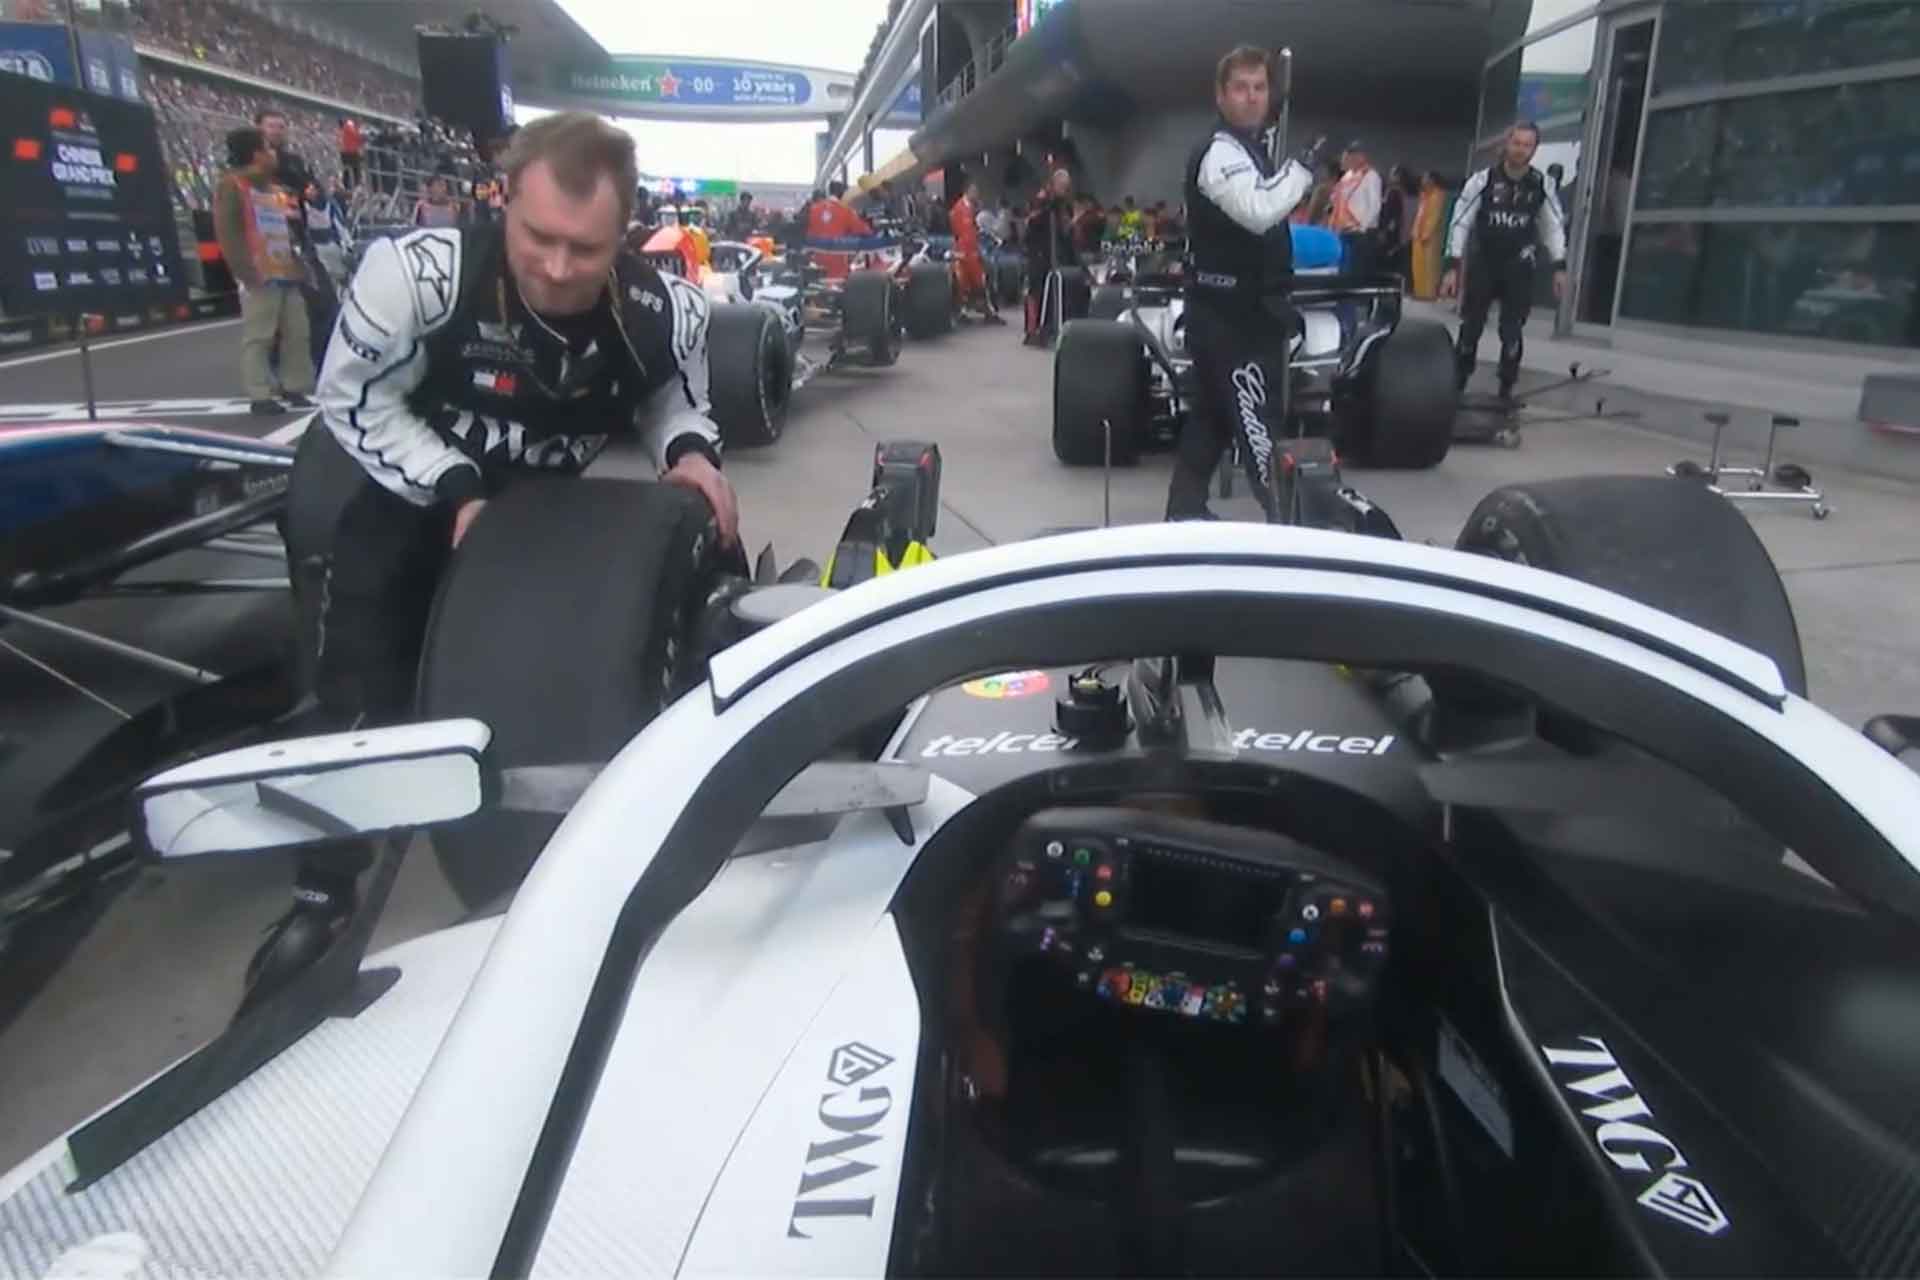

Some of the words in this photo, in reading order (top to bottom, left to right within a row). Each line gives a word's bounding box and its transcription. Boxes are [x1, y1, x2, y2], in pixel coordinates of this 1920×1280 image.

[1232, 728, 1395, 756] telcel
[787, 1085, 893, 1239] TWG
[1541, 1035, 1689, 1174] TWG
